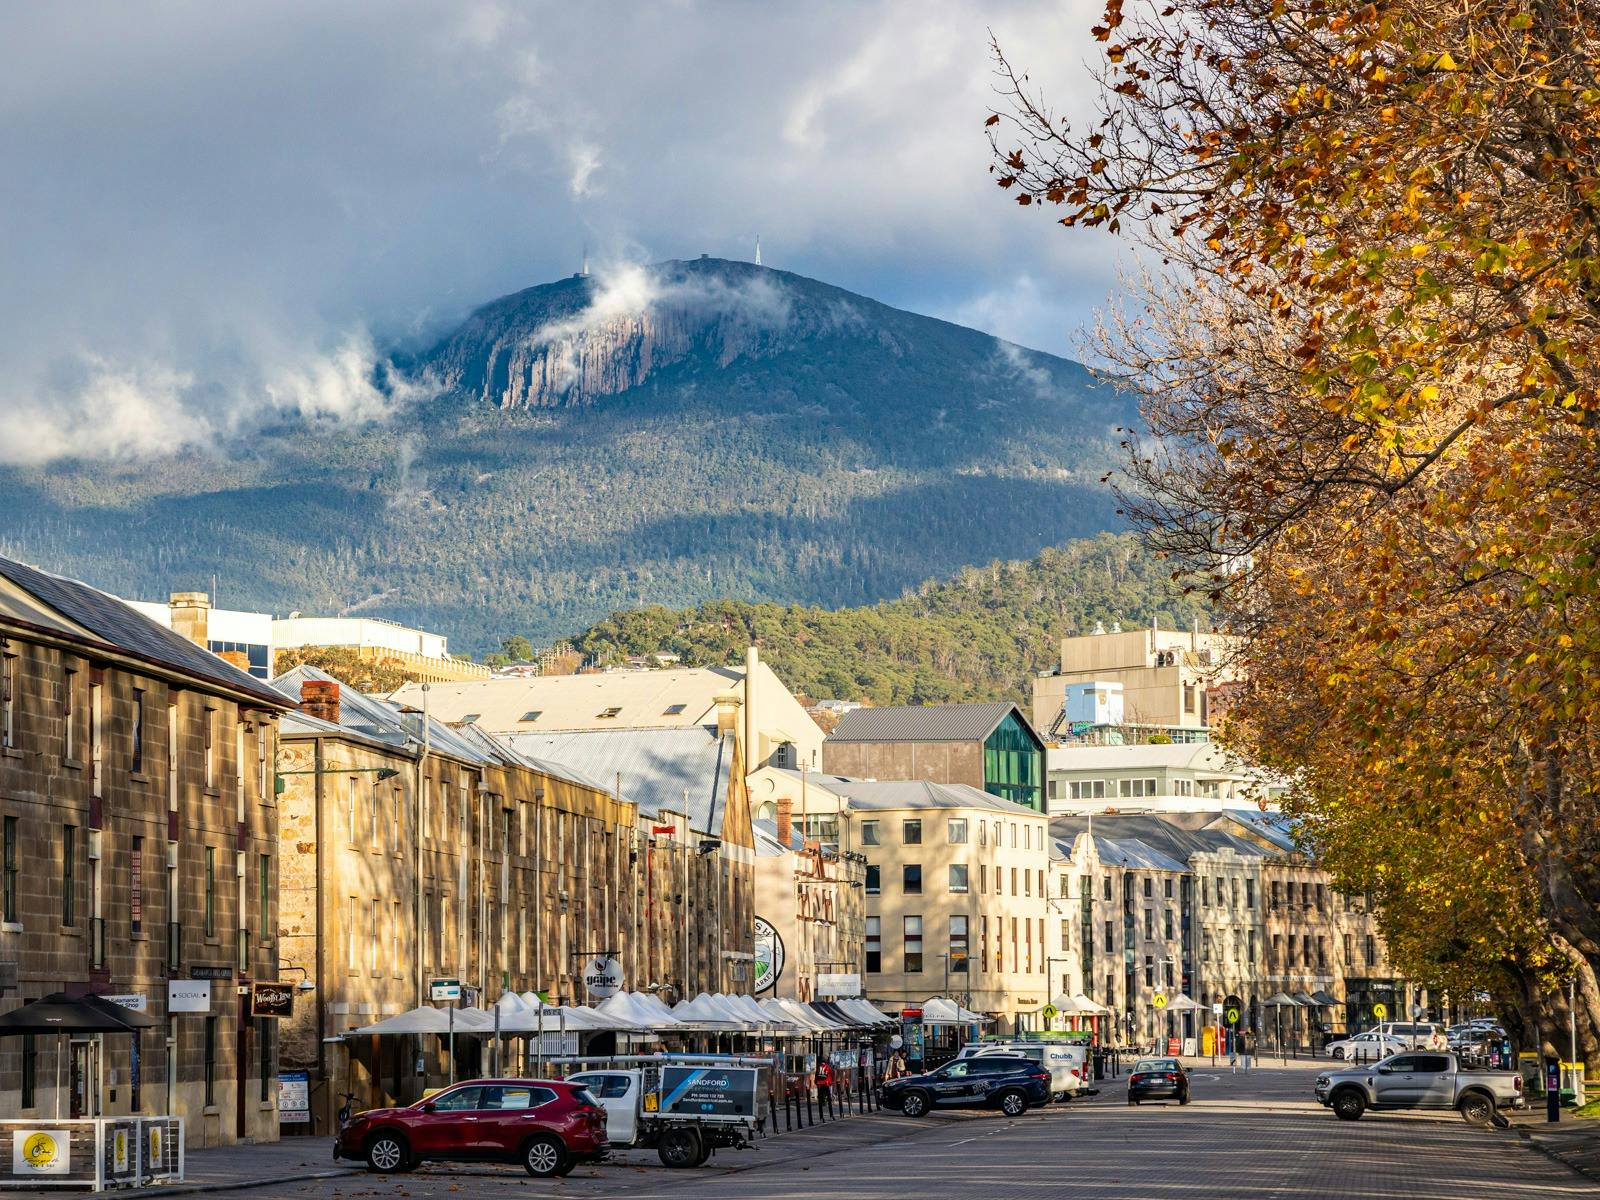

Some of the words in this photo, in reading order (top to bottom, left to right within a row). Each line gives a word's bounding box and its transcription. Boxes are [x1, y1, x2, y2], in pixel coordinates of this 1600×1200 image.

[755, 922, 772, 937] SH
[586, 976, 616, 988] grape
[755, 971, 774, 988] ARKET
[1050, 1052, 1072, 1060] Chubb
